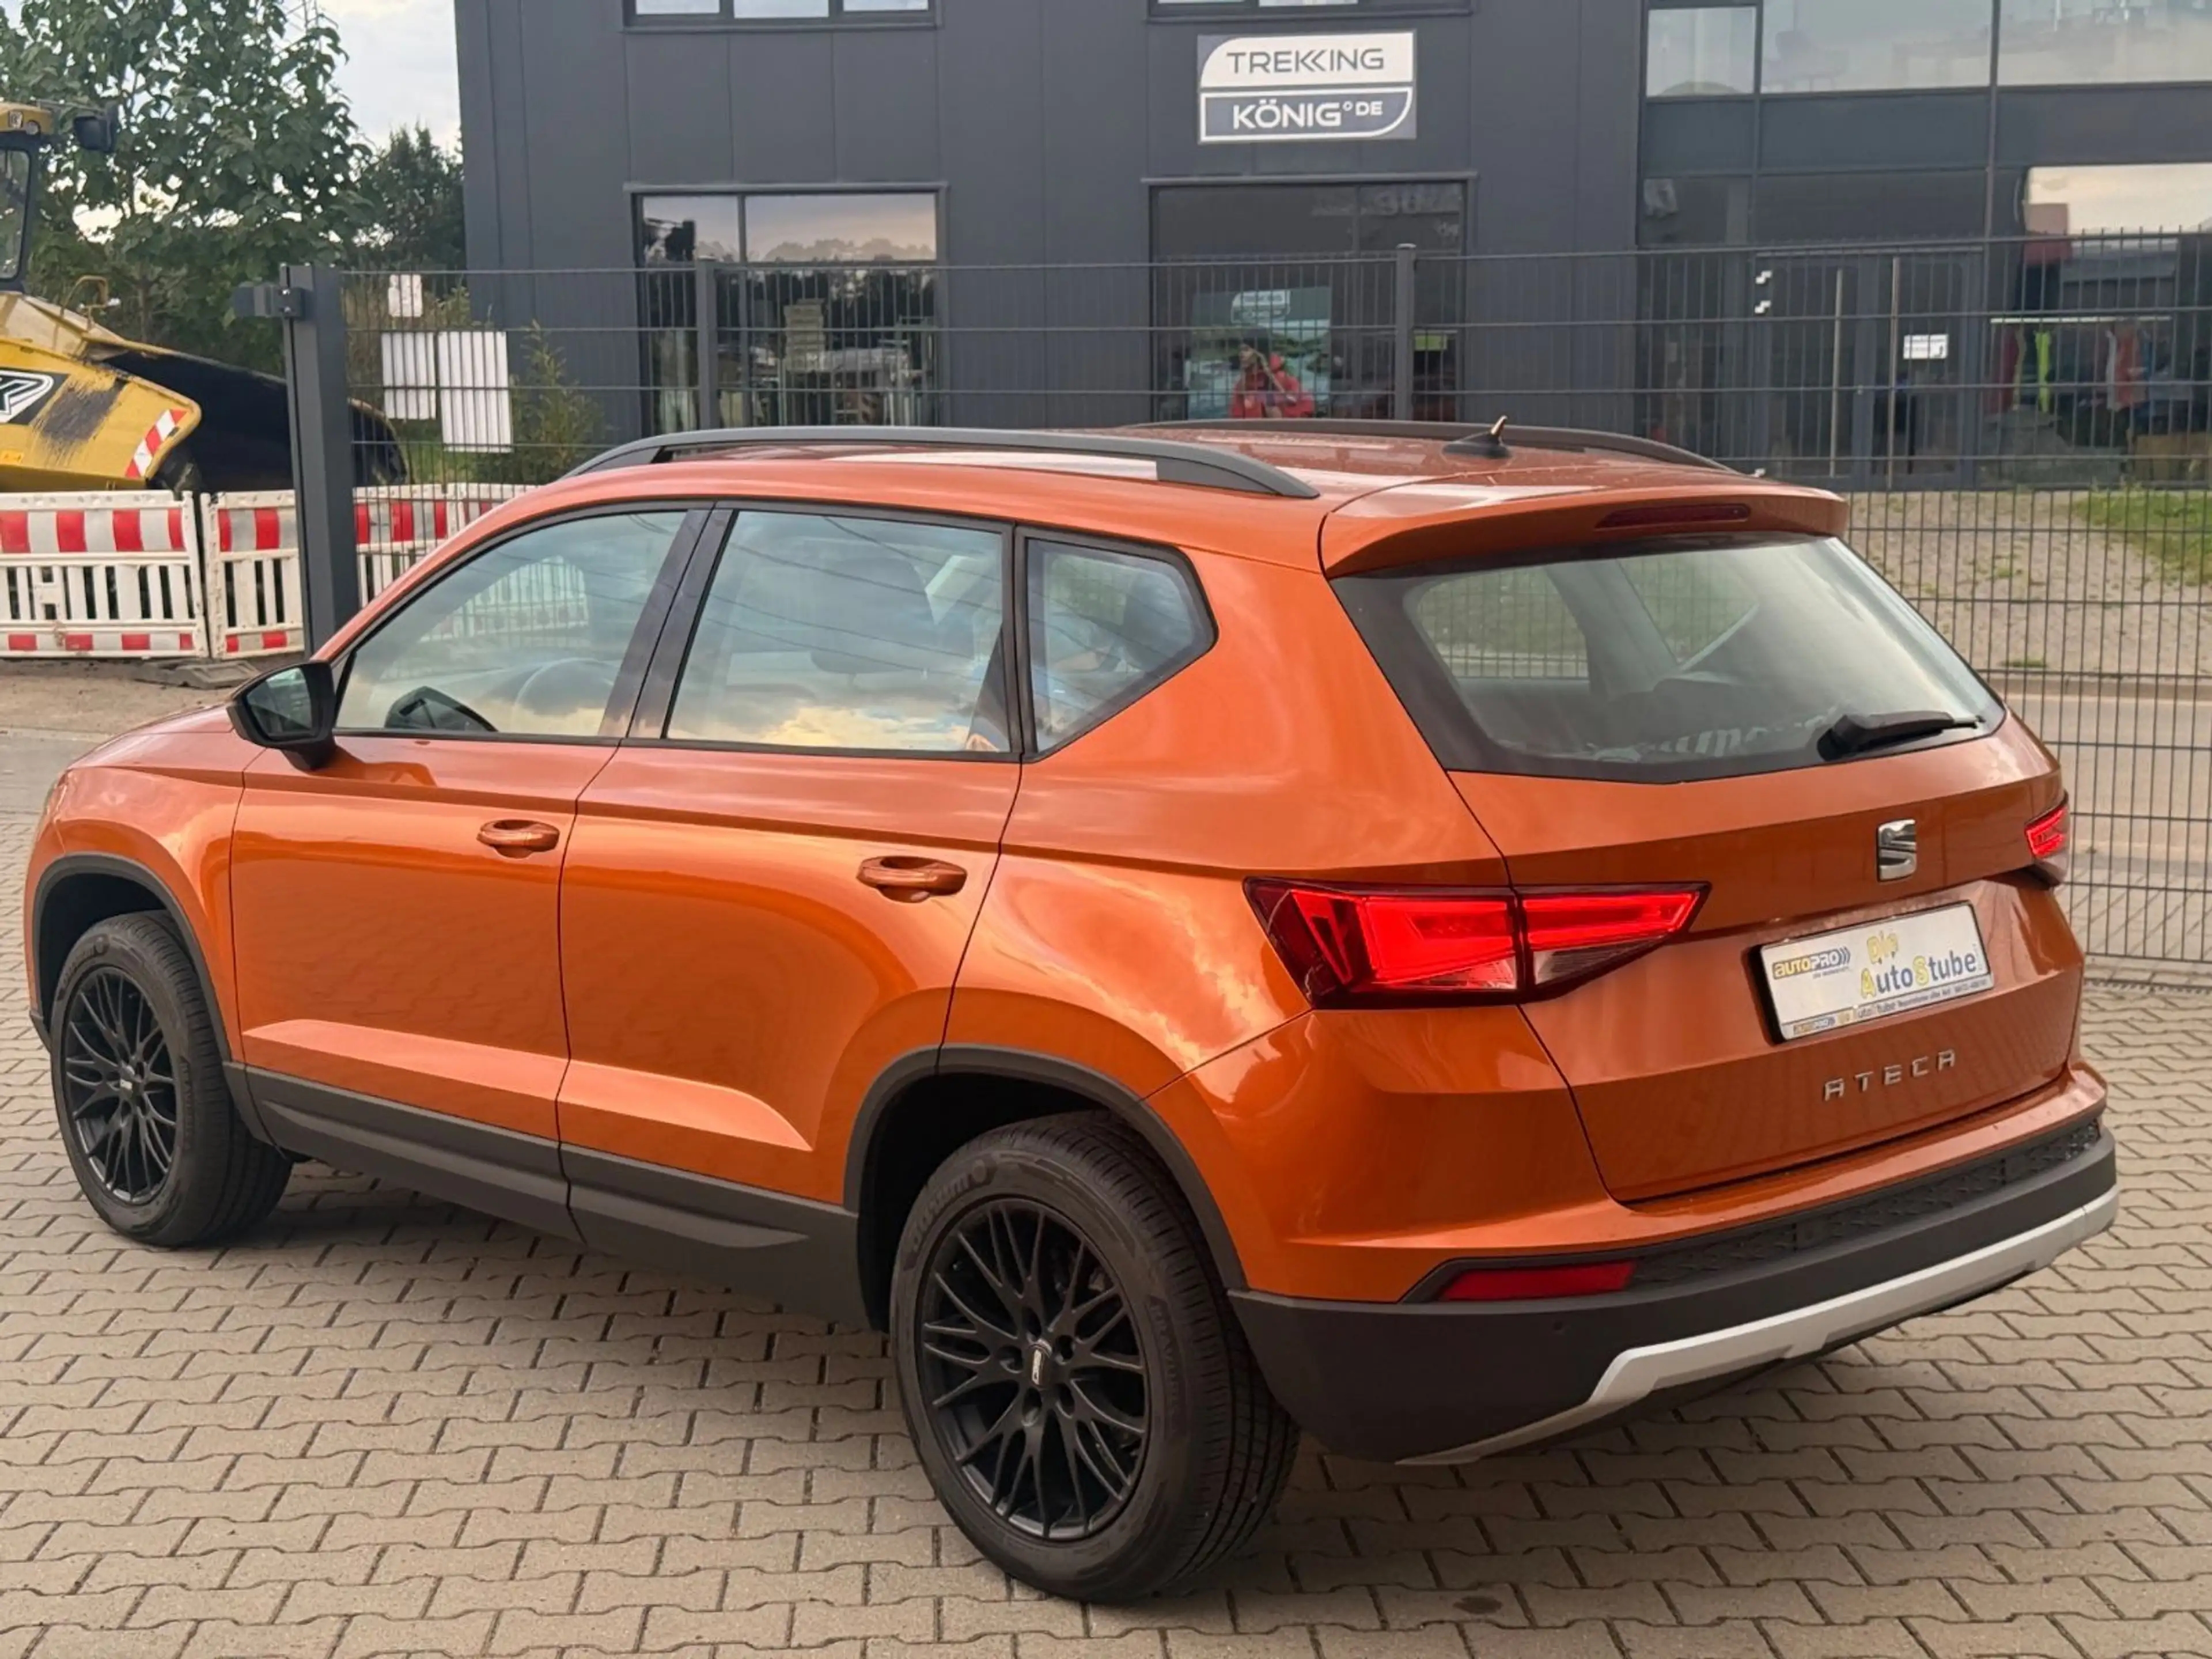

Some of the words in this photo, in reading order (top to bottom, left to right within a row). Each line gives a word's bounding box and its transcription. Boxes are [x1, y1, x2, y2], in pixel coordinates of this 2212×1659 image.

[1226, 48, 1384, 74] TREKKING
[1860, 949, 1976, 999] AutoStube
[1824, 1048, 1956, 1101] ATECA
